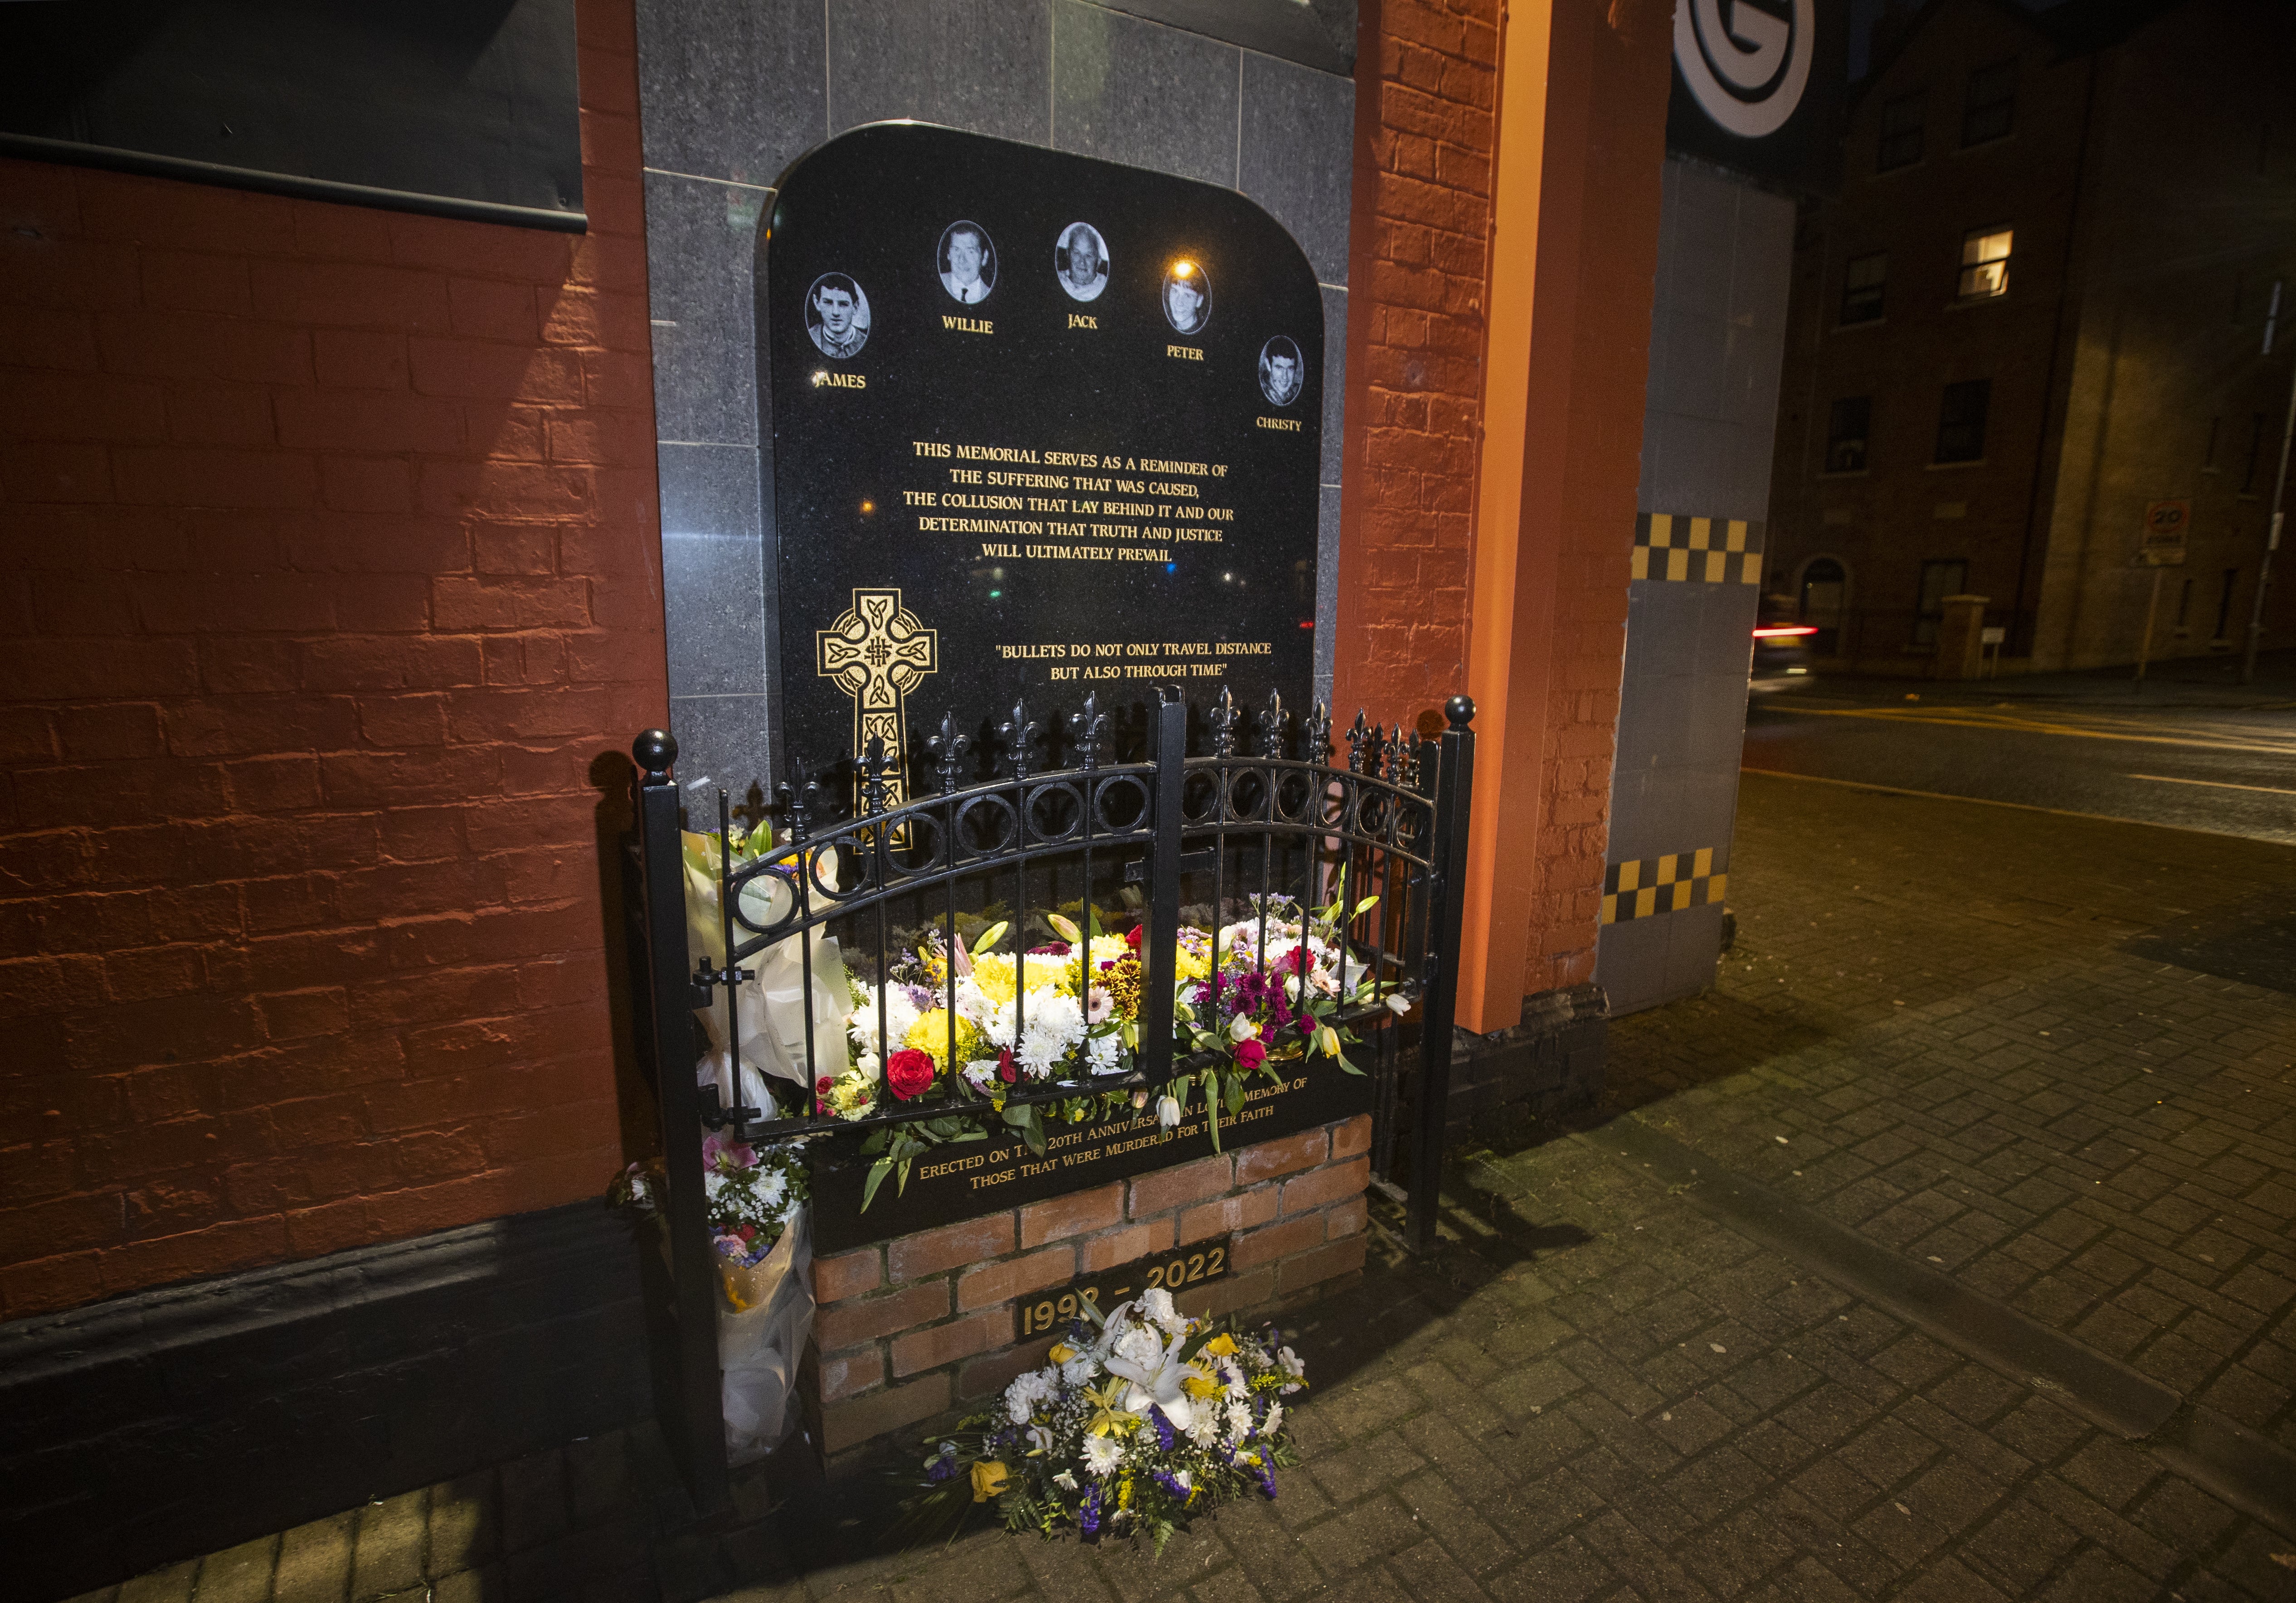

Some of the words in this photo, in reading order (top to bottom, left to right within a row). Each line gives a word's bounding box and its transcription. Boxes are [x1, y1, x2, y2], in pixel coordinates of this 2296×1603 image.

[942, 316, 993, 334] WILLIE
[1068, 314, 1098, 329] JACK
[1167, 345, 1203, 360] PETER
[814, 371, 866, 389] JAMES
[1256, 417, 1301, 431] CHRISTY
[913, 442, 951, 458] THIS
[956, 445, 1040, 464] MEMORIAL
[1044, 452, 1098, 468] SERVES
[1102, 456, 1121, 469] AS
[1125, 457, 1136, 470] A
[1140, 459, 1208, 476] REMINDER
[1211, 464, 1228, 477] OF
[950, 469, 983, 484] THE
[987, 471, 1069, 489] SUFFERING
[1073, 476, 1112, 491] THAT
[1116, 480, 1145, 494] WAS
[1149, 482, 1199, 499] CAUSED,
[903, 491, 937, 506] THE
[942, 493, 1023, 510] COLLUSION
[1027, 497, 1068, 512] THAT
[1072, 500, 1099, 514] LAY
[1103, 502, 1154, 516] BEHIND
[1158, 505, 1172, 517] IT
[1175, 506, 1204, 519] AND
[1207, 508, 1233, 520] OUR
[2155, 510, 2182, 524] 20
[919, 517, 1042, 534] DETERMINATION
[1047, 522, 1086, 536] THAT
[1090, 525, 1137, 538] TRUTH
[1142, 526, 1172, 539] AND
[1175, 528, 1222, 543] JUSTICE
[982, 544, 1022, 558] WILL
[1026, 545, 1114, 560] ULTIMATELY
[1118, 548, 1172, 562] PREVAIL
[996, 645, 1065, 658] "BULLETS
[1070, 644, 1091, 657] DO
[1095, 644, 1123, 656] NOT
[1127, 644, 1159, 656] ONLY
[1163, 643, 1211, 655] TRAVEL
[1216, 643, 1271, 654] DISTANCE
[1051, 667, 1080, 680] BUT
[1083, 666, 1120, 679] ALSO
[1124, 665, 1187, 677] THROUGH
[1191, 663, 1227, 676] TIME"
[920, 1156, 984, 1179] ERECTED
[989, 1149, 1009, 1163] ON
[1048, 1132, 1082, 1149] 20TH
[1087, 1114, 1161, 1140] ANNIVERSA
[1180, 1105, 1192, 1118] N
[1245, 1082, 1290, 1102] MEMORY
[1294, 1078, 1307, 1089] OF
[970, 1169, 1015, 1189] THOSE
[1021, 1159, 1057, 1176] THAT
[1062, 1149, 1100, 1166] WERE
[1178, 1125, 1198, 1138] FOR
[1202, 1116, 1237, 1132] TEIR
[1241, 1106, 1273, 1122] FAITH
[1147, 1247, 1225, 1288] 2022
